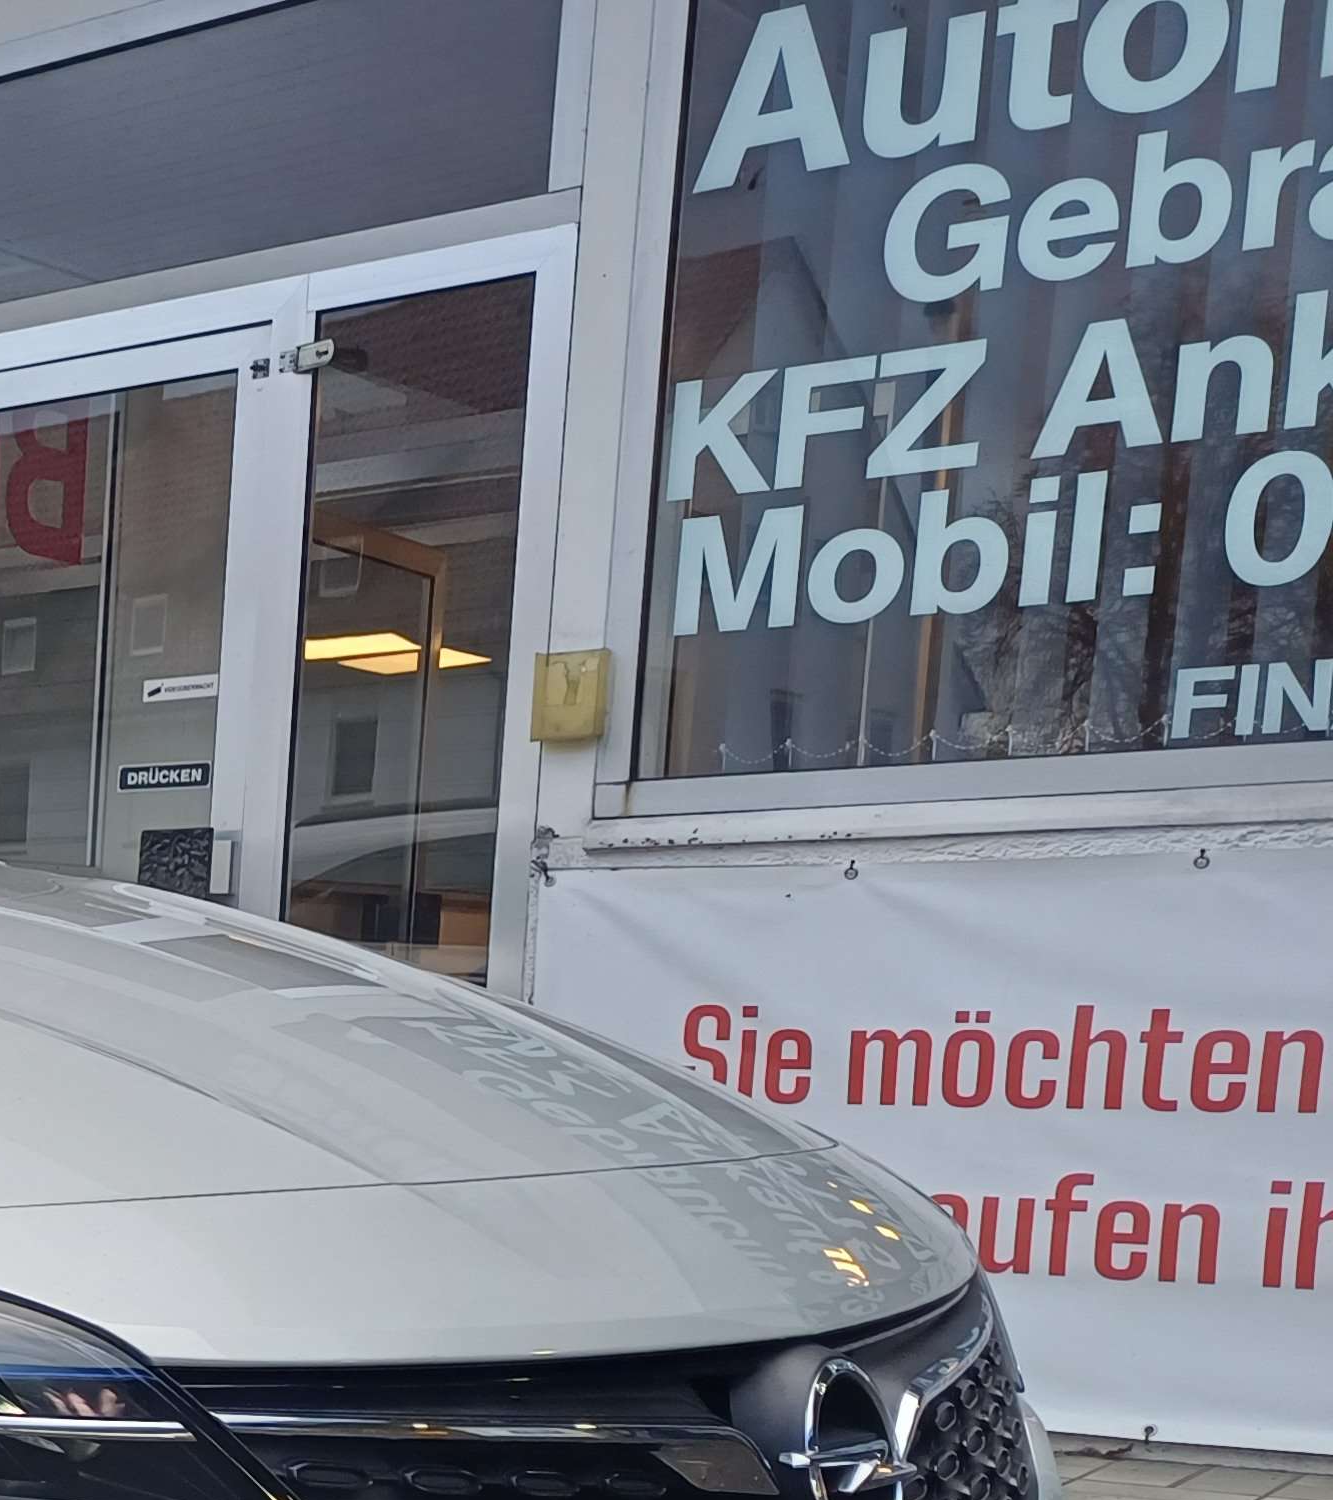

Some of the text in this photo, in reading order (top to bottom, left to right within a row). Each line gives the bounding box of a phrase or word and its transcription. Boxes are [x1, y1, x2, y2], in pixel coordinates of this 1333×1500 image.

[667, 338, 988, 502] KFZ
[673, 469, 1162, 636] Mobil:
[126, 766, 203, 786] DRÜCKEN
[683, 1003, 813, 1105] Sie
[846, 1004, 1325, 1113] möchten
